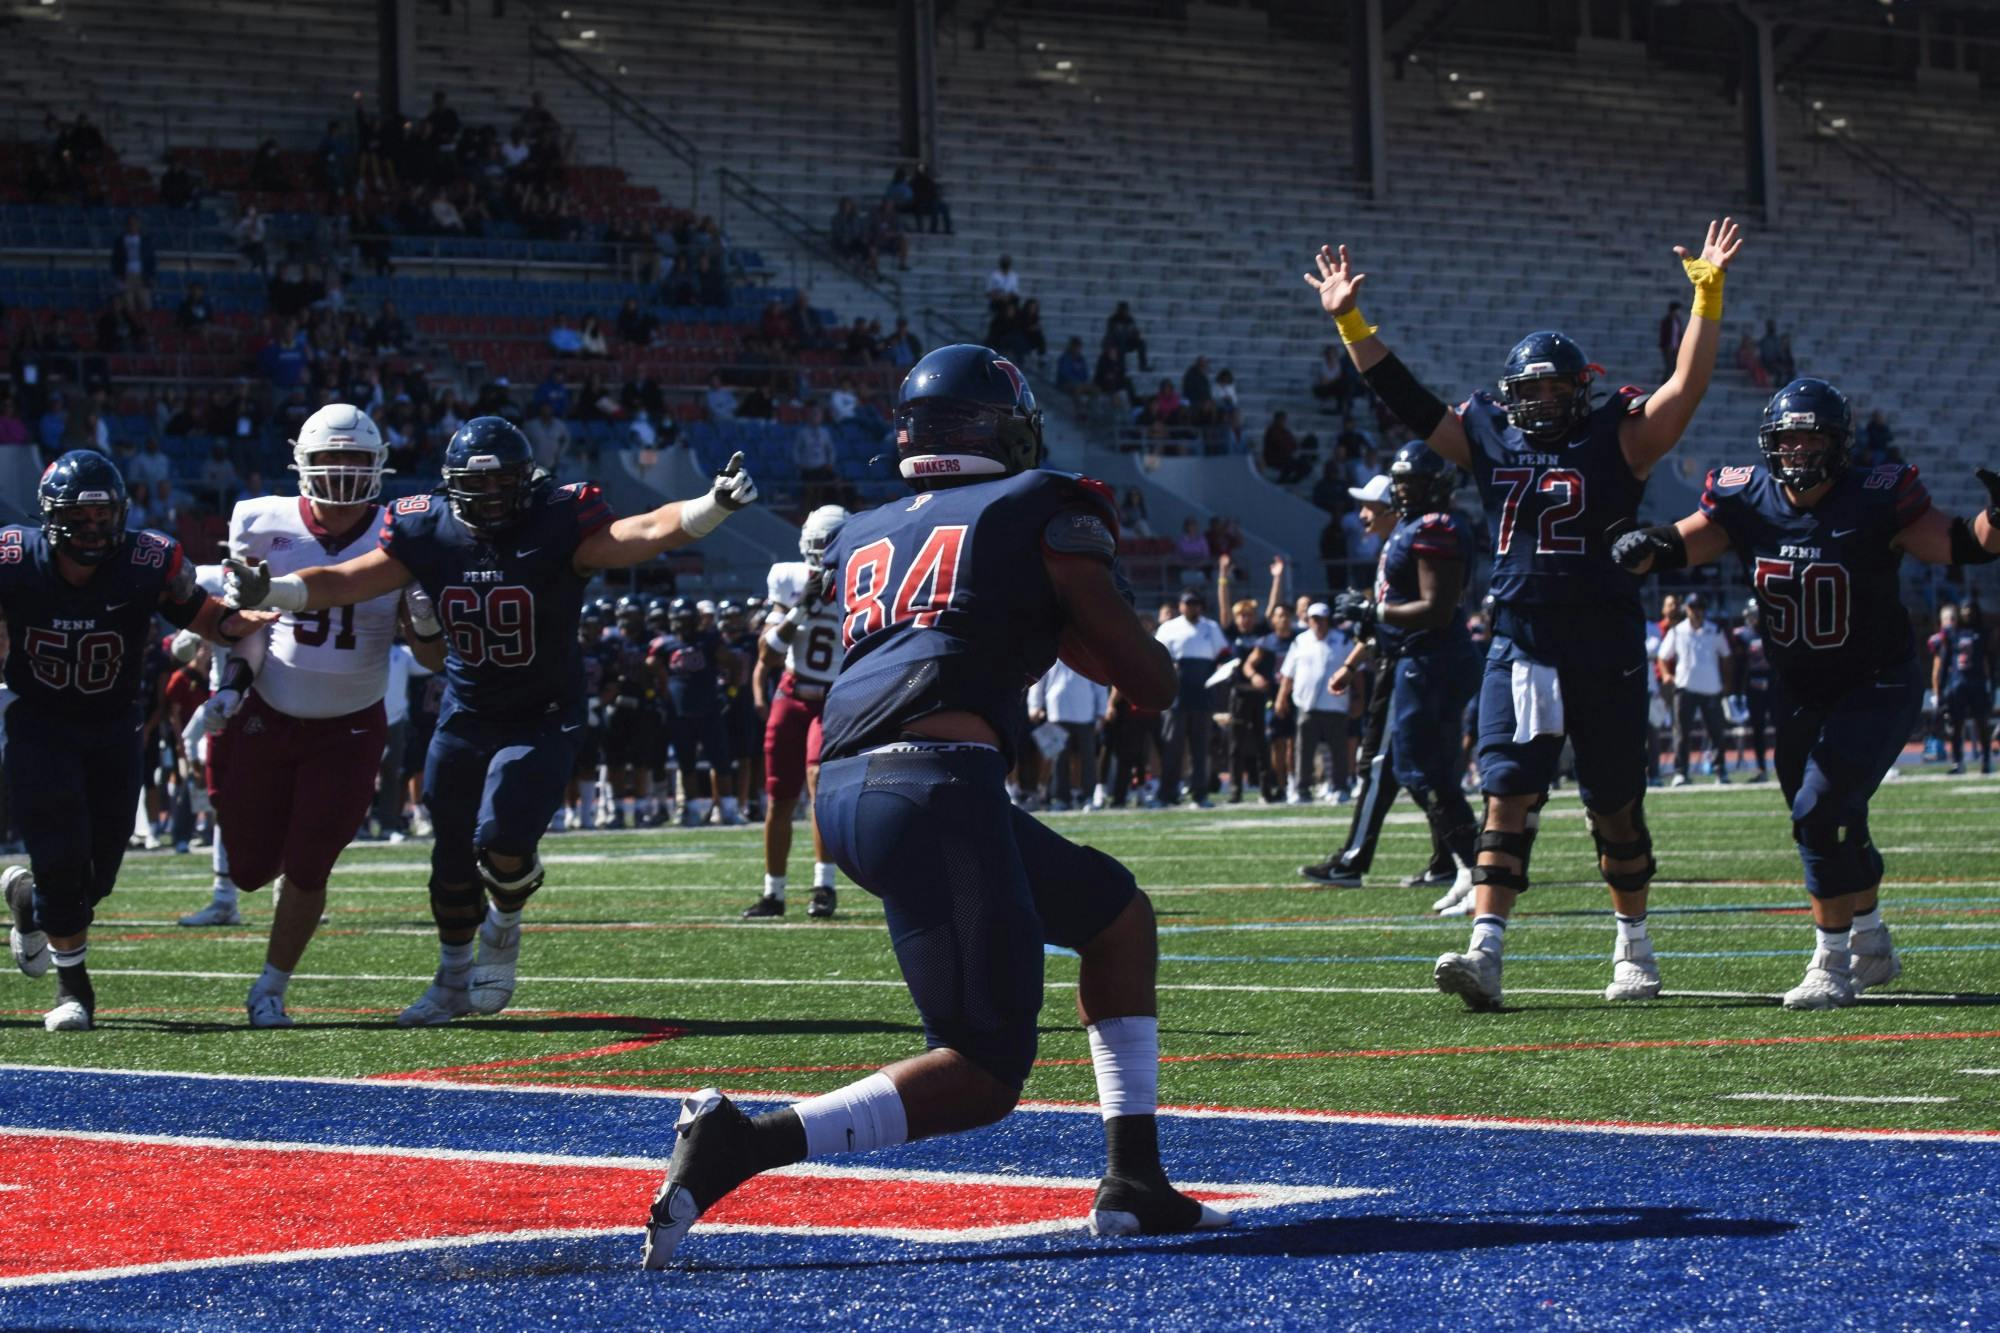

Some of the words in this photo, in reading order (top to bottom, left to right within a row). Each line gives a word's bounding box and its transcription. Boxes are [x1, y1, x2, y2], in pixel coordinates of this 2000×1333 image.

[913, 459, 961, 475] QUAKERS
[1517, 453, 1560, 466] PENN
[1491, 468, 1585, 555] 72
[131, 532, 170, 568] 58
[1779, 545, 1822, 559] PENN
[463, 571, 504, 583] PENN
[843, 525, 968, 650] 84
[1755, 556, 1850, 650] 50
[52, 619, 97, 630] PENN
[439, 585, 536, 667] 69
[24, 626, 124, 695] 58
[805, 626, 836, 672] 6
